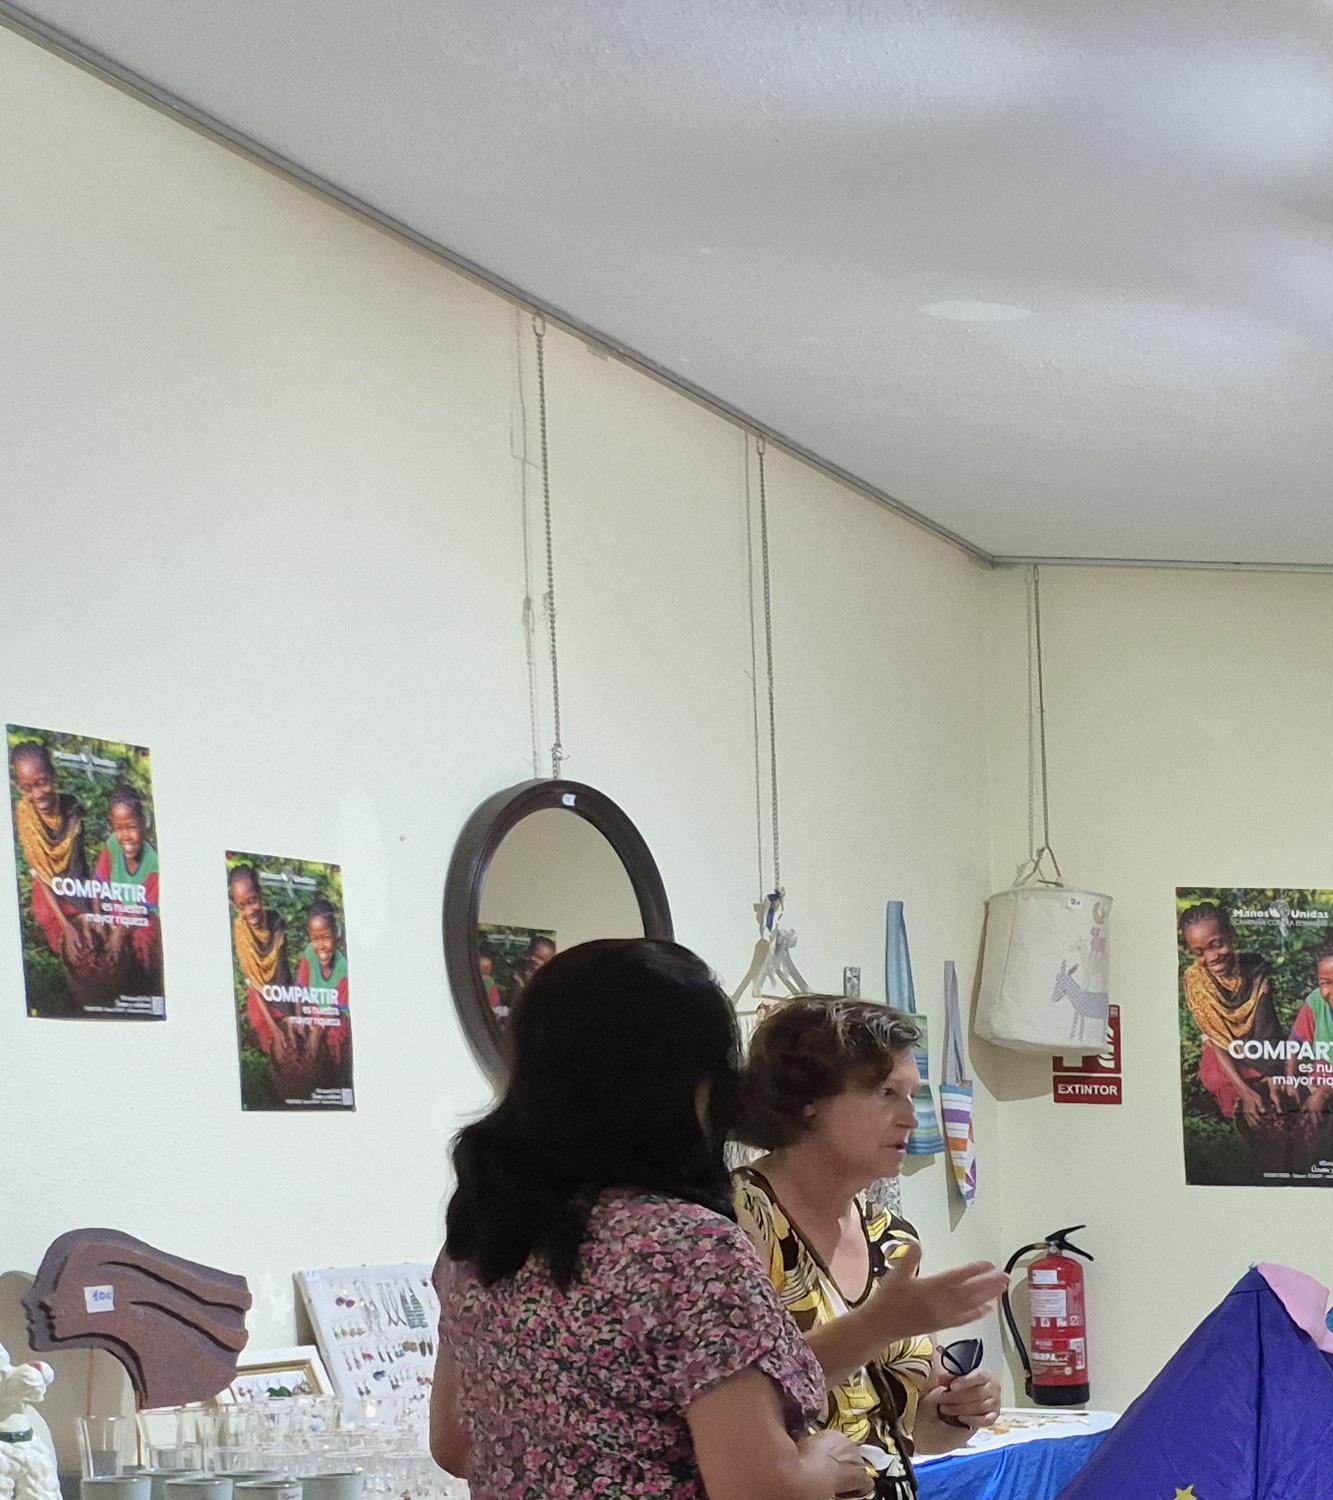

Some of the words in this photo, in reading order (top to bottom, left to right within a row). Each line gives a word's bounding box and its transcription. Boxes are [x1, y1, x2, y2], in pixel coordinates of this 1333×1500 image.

[52, 876, 146, 903] COMPARTIR
[1232, 909, 1269, 918] Manos
[1291, 909, 1328, 918] Unidas
[263, 984, 340, 1006] COMPARTIR
[1298, 1063, 1313, 1073] es
[1273, 1076, 1313, 1088] mayor
[1058, 1083, 1118, 1096] EXTINTOR
